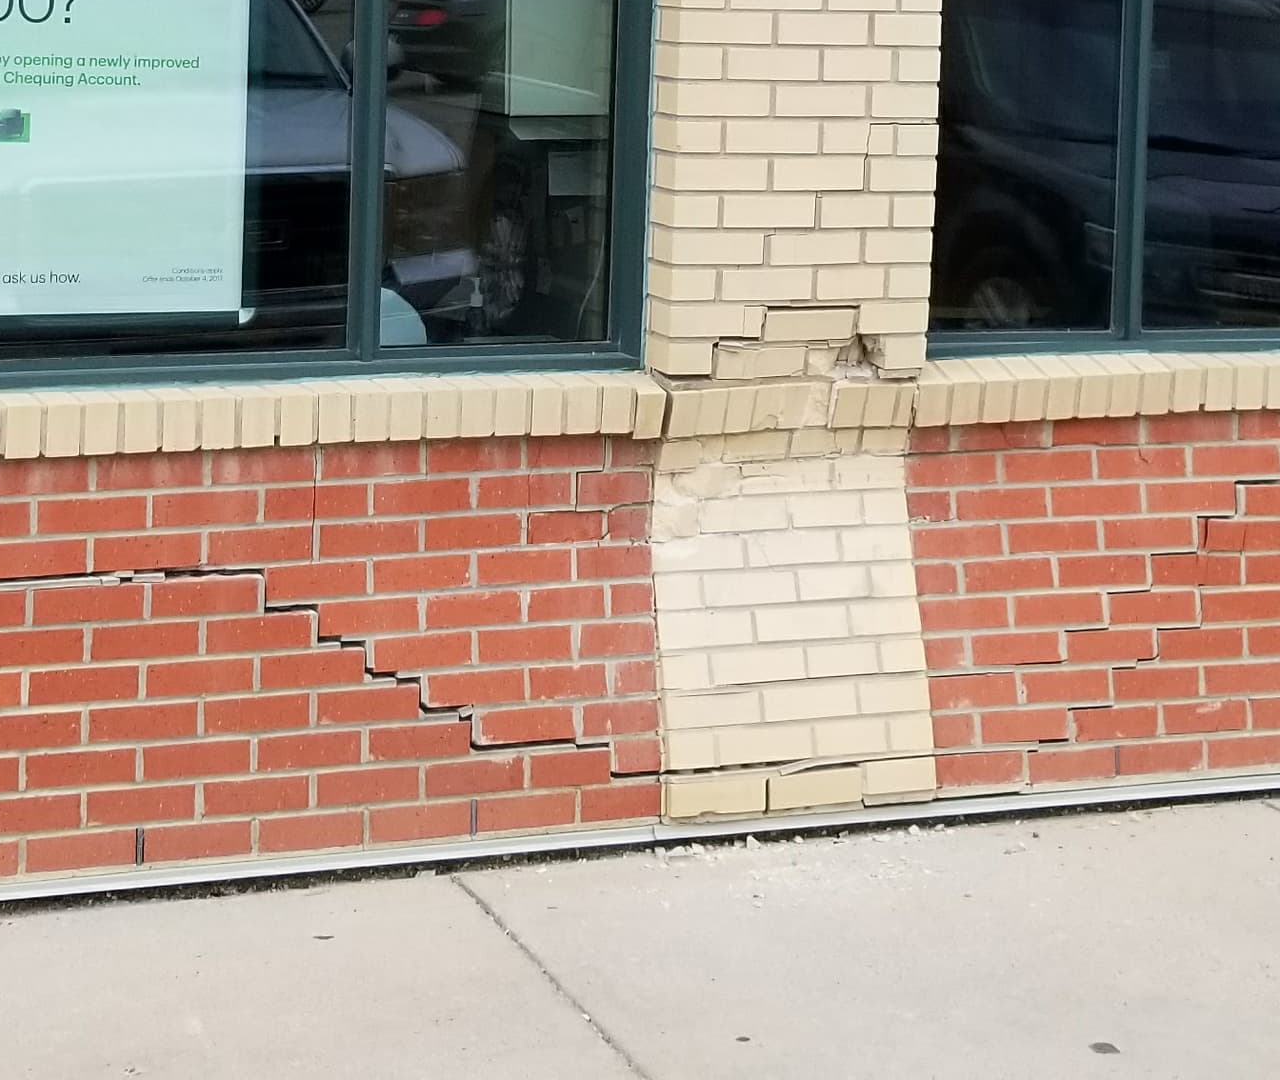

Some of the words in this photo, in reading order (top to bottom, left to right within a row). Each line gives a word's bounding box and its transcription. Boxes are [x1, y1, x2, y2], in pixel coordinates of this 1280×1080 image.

[13, 53, 73, 69] opening
[76, 56, 86, 68] a
[89, 54, 132, 70] newly
[134, 55, 201, 71] improved
[3, 71, 74, 88] Chequing
[76, 72, 142, 87] Account.
[1, 270, 27, 285] ask
[29, 273, 47, 285] us
[49, 270, 81, 285] how.
